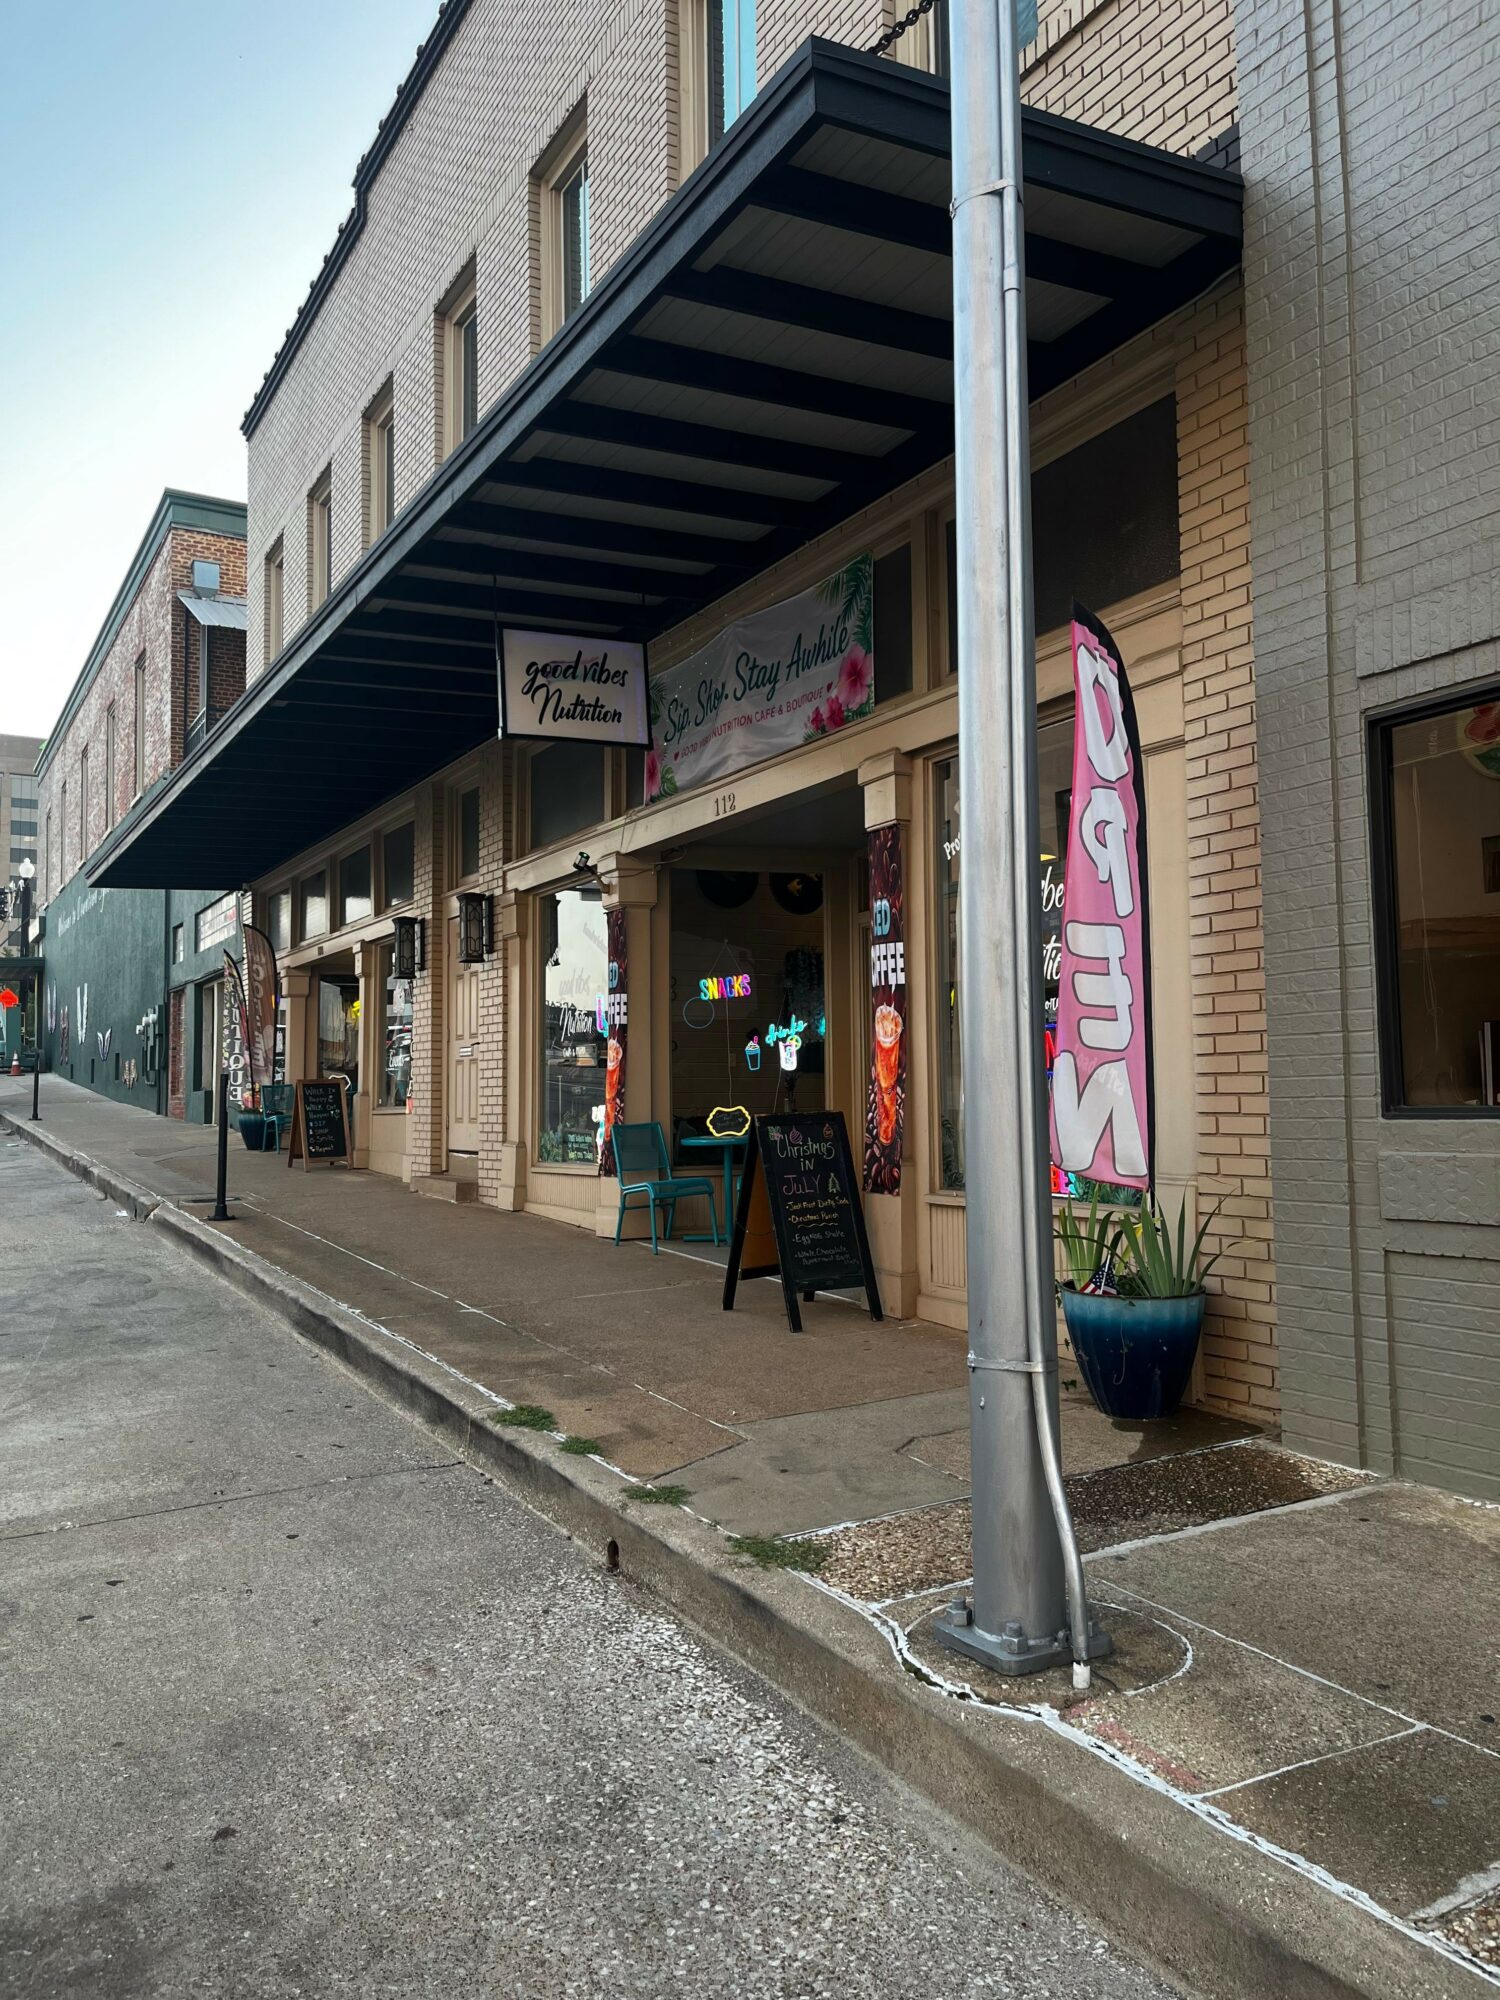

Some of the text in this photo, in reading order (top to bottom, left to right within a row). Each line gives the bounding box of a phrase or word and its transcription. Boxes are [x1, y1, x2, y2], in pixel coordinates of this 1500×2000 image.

[521, 649, 629, 696] good vibes
[664, 698, 692, 744] Sip.
[733, 651, 781, 702] Stay
[785, 615, 849, 682] Awhile
[530, 682, 623, 726] Nutrition
[711, 713, 753, 739] NUTRITION
[777, 704, 784, 716] &
[786, 688, 824, 712] BOUTIQUE
[714, 792, 736, 817] 112
[943, 831, 961, 861] Pro
[873, 897, 891, 937] ED
[871, 941, 906, 988] OFFEE
[699, 973, 752, 1001] SNACKS
[559, 1002, 593, 1042] Nutrition
[764, 1013, 808, 1047] drinks
